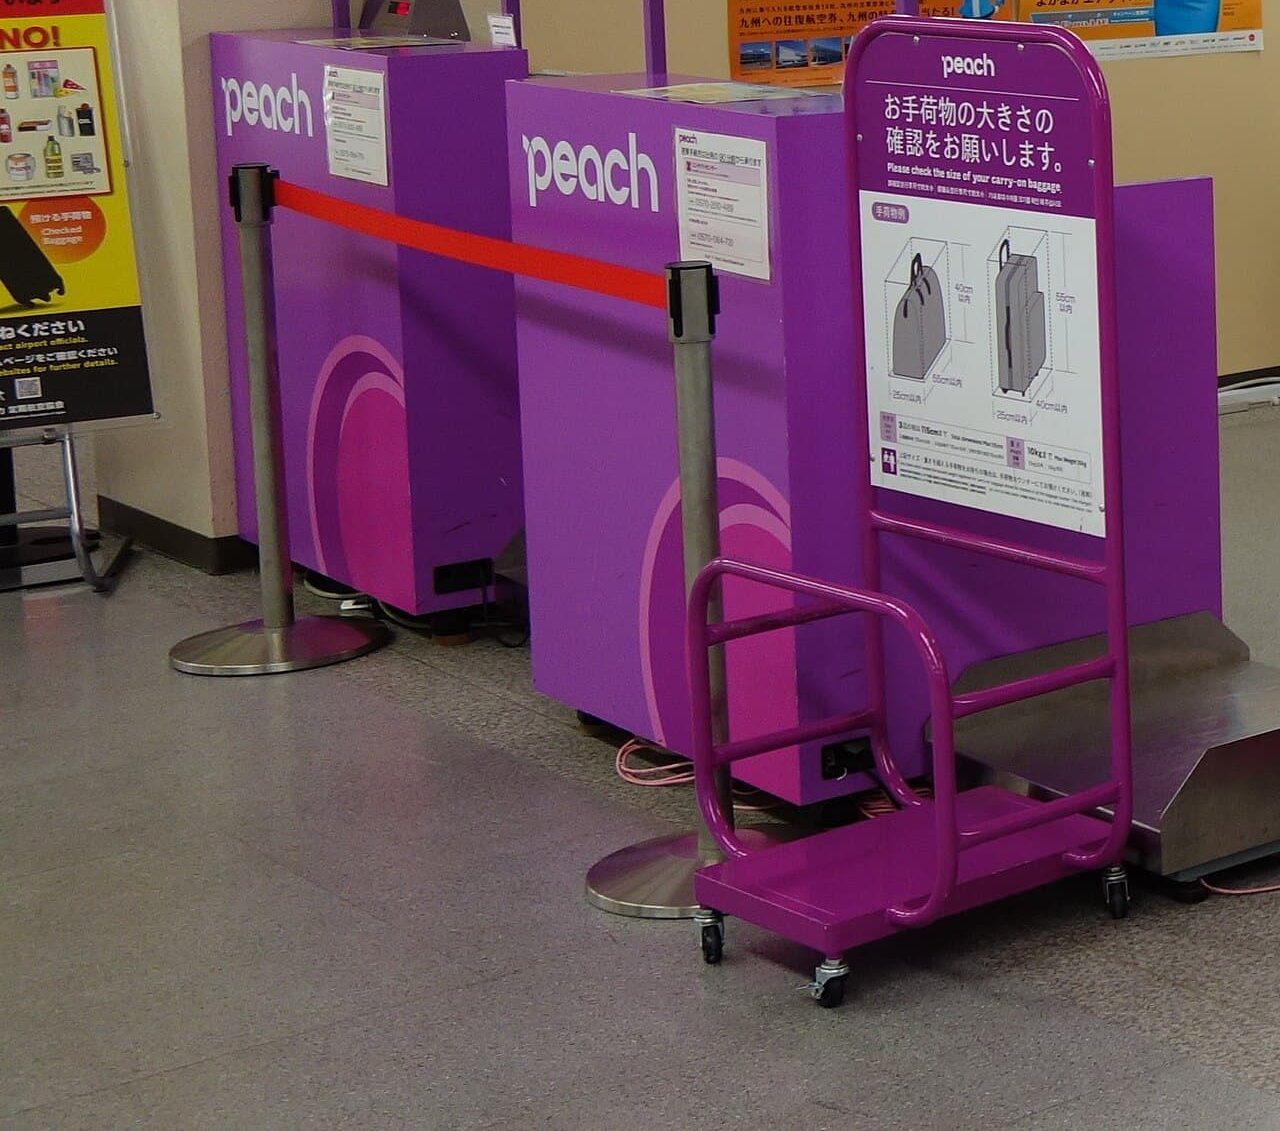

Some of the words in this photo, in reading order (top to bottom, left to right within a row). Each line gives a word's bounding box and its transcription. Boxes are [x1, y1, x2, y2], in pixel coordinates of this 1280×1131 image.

[0, 26, 61, 49] NO!
[941, 53, 996, 78] peach
[221, 71, 314, 137] peach
[884, 94, 1054, 134] お手荷物の大きさの
[885, 125, 1062, 173] 確認をお願いします。
[522, 132, 659, 213] peach
[887, 163, 910, 174] Please
[911, 166, 932, 176] check
[933, 168, 945, 178] the
[946, 169, 961, 180] size
[962, 171, 971, 181] of
[972, 173, 990, 184] your
[991, 175, 1027, 188] carry-on
[1028, 179, 1062, 194] baggage.
